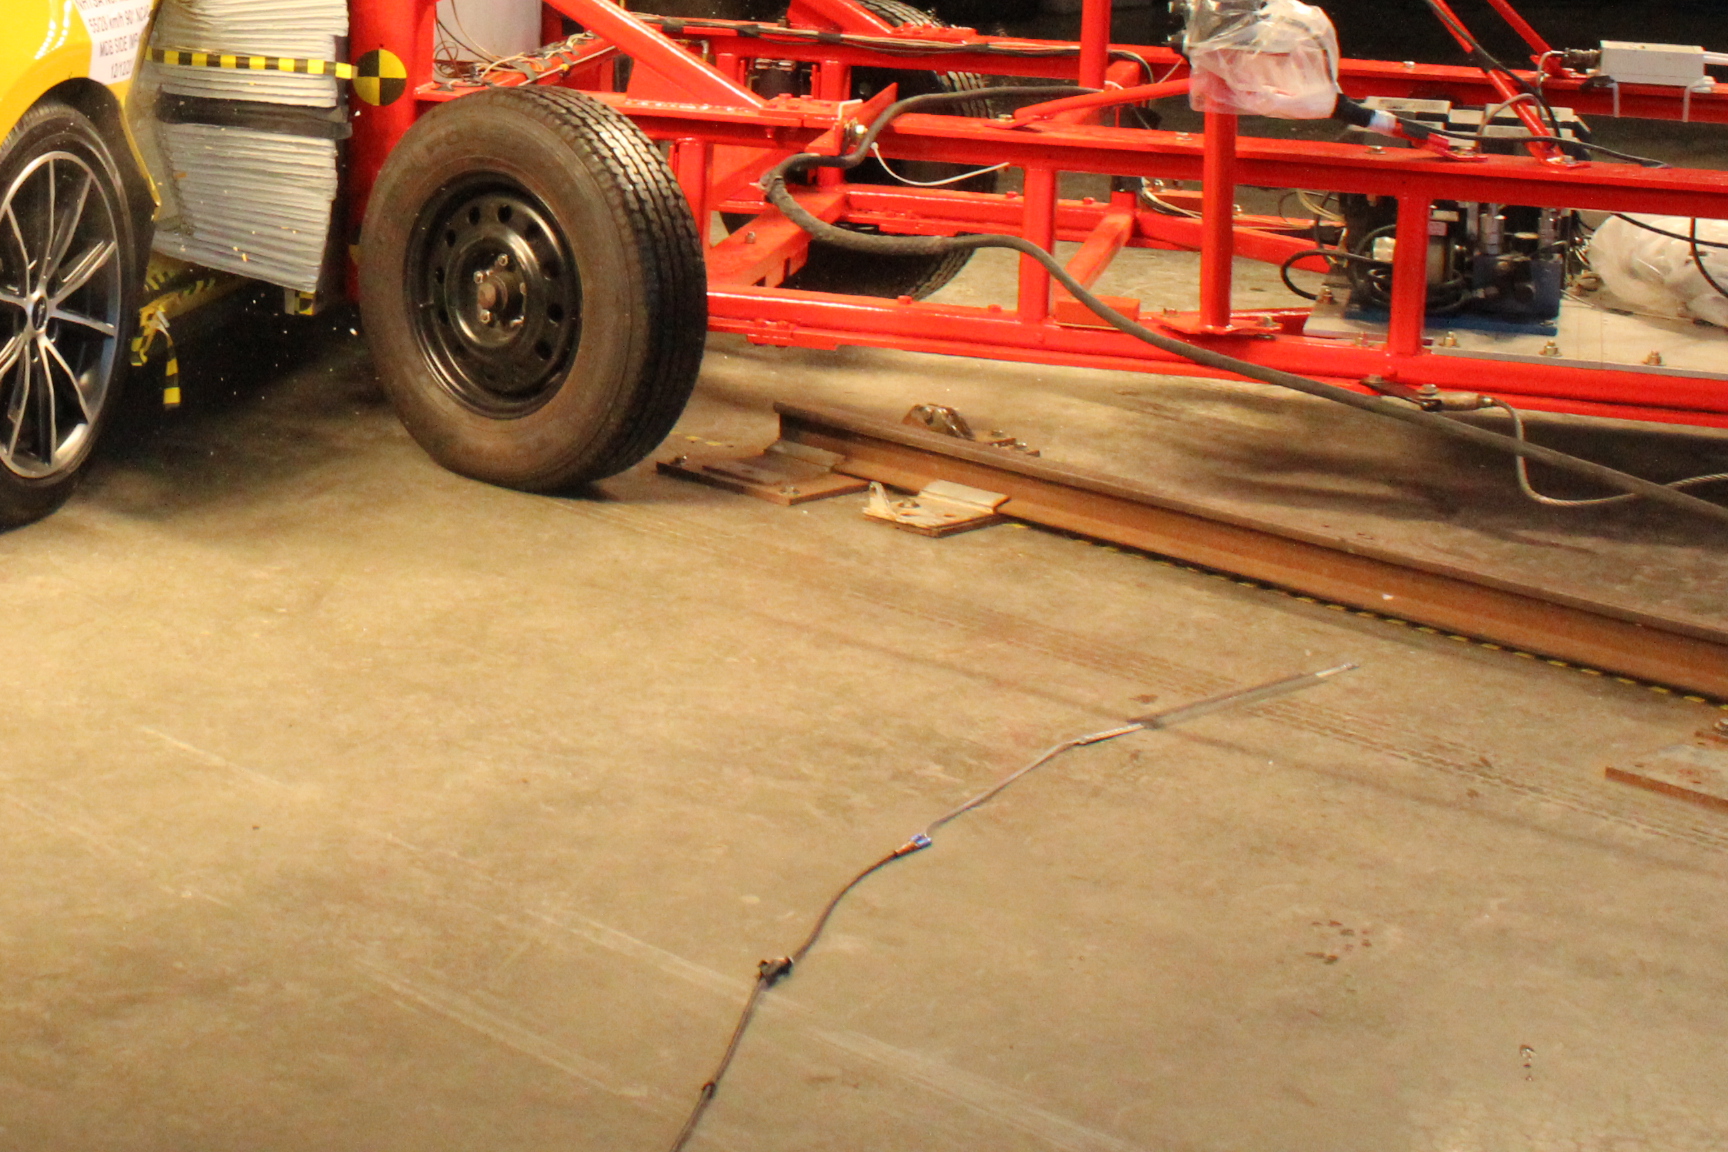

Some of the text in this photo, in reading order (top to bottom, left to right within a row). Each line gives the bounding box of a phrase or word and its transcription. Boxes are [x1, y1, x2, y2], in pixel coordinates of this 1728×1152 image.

[88, 15, 109, 34] 55/28
[99, 38, 114, 58] MDB
[114, 35, 128, 54] SIDE
